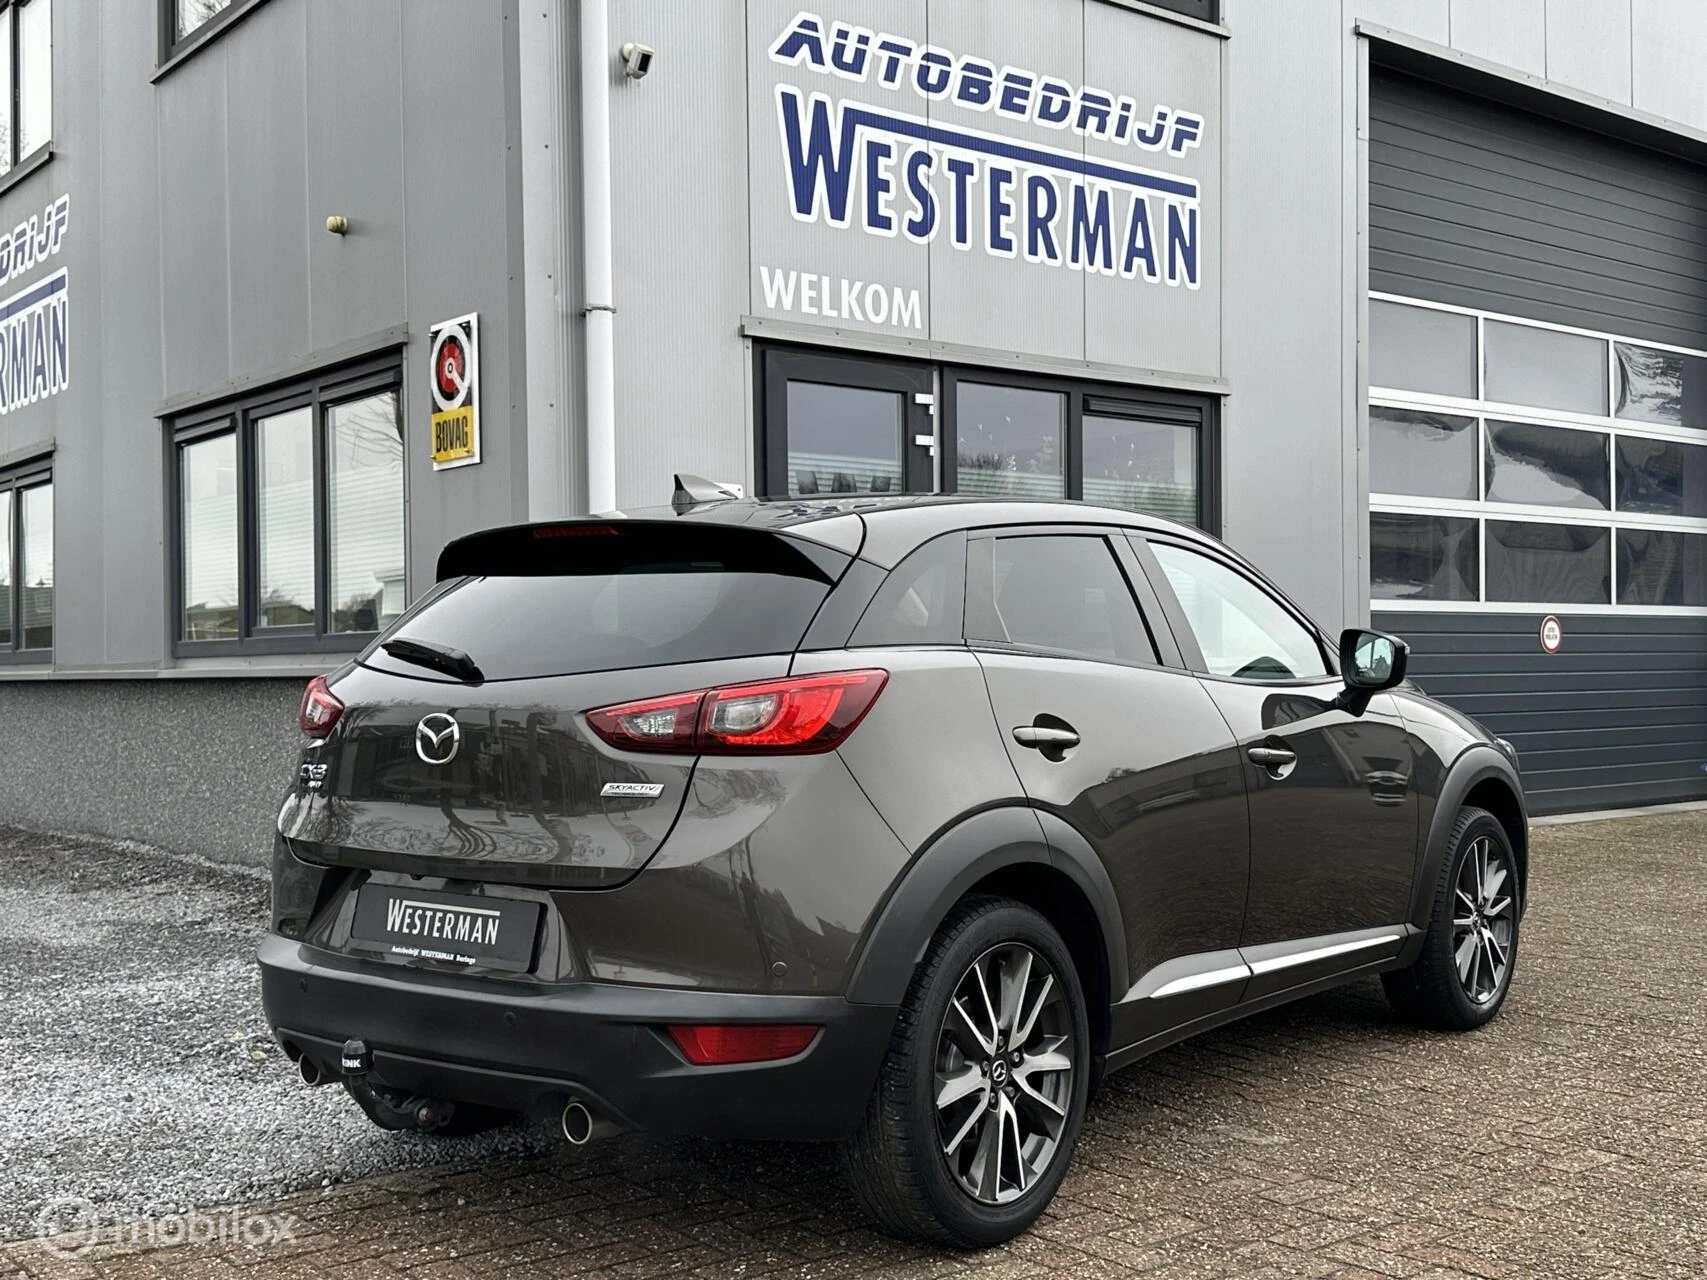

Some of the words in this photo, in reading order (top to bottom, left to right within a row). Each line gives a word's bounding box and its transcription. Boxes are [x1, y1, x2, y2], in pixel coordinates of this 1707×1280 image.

[772, 16, 1202, 155] AUTOBEDRIJF
[778, 88, 1198, 286] WESTERMAN
[759, 266, 923, 329] WELKOM
[435, 415, 468, 453] BOVAG
[608, 784, 656, 792] SKYACTIV
[386, 898, 500, 945] WESTERMAN
